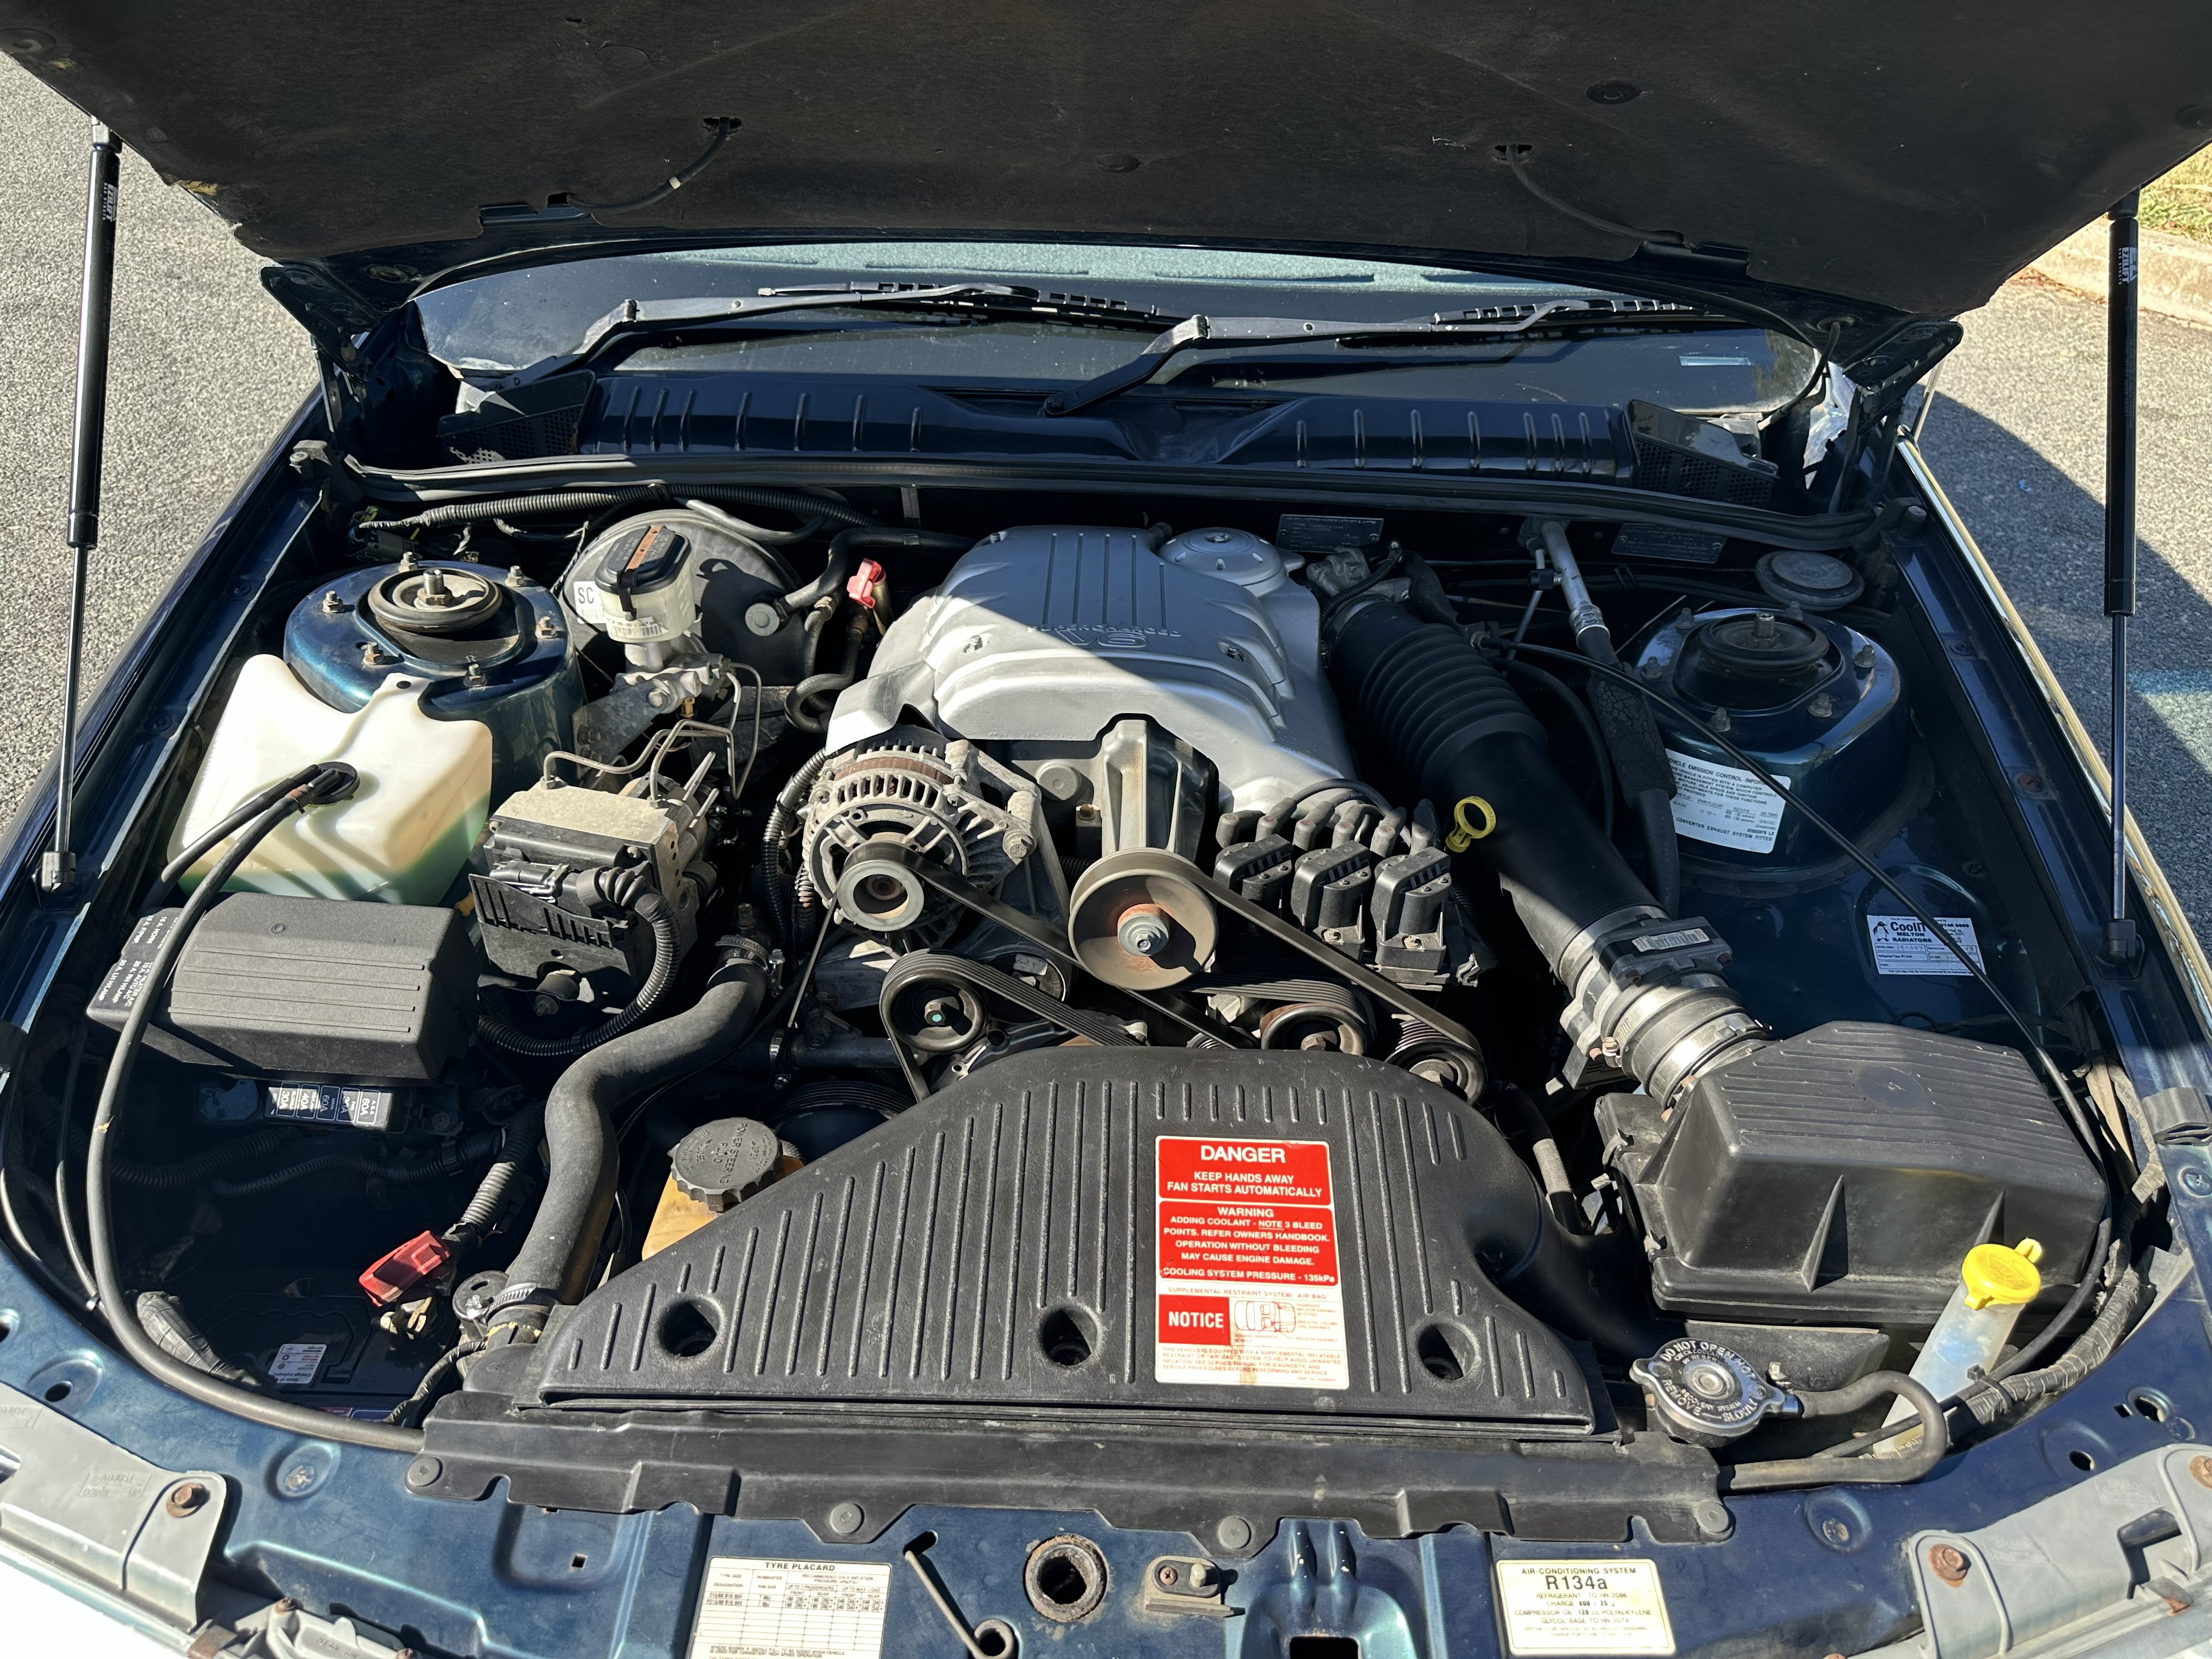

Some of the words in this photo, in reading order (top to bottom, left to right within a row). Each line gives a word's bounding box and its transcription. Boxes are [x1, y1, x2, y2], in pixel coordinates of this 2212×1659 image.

[106, 184, 114, 222] EZILIFT
[578, 587, 594, 603] SC
[1028, 624, 1181, 637] SUPERCHARGED
[1056, 630, 1147, 648] V6
[1668, 758, 1686, 768] EHICLE
[1688, 765, 1713, 775] EMISSION
[1716, 772, 1742, 781] CONTROL
[1682, 783, 1713, 794] ADJUSTMENTS
[1684, 775, 1714, 785] MANAGEMENT
[1676, 817, 1705, 828] CONVERTER
[1707, 826, 1730, 834] EXHAUST
[146, 928, 160, 944] HORN
[124, 974, 133, 983] RH
[129, 974, 140, 990] AUTO
[99, 980, 114, 1001] H/LAMP
[112, 983, 128, 1003] H/LAMP
[279, 1091, 290, 1109] 30A
[300, 1093, 309, 1110] 40A
[320, 1094, 329, 1112] 60A
[341, 1096, 350, 1113] 30A
[360, 1098, 370, 1115] 60A
[732, 1123, 747, 1148] POWER
[713, 1142, 728, 1164] FLUID
[1200, 1145, 1286, 1164] DANGER
[719, 1149, 739, 1184] STEERING
[1194, 1171, 1222, 1181] KEEP
[1224, 1173, 1262, 1183] HANDS
[1265, 1175, 1294, 1184] AWAY
[1167, 1182, 1188, 1192] FAN
[1190, 1183, 1232, 1194] STARTS
[1234, 1186, 1322, 1198] AUTOMATICALLY
[1217, 1207, 1274, 1218] WARNING
[1170, 1216, 1205, 1224] ADDING
[1207, 1217, 1251, 1226] COOLANT
[1259, 1220, 1283, 1228] NOTE
[1164, 1228, 1199, 1236] POINTS.
[1233, 1231, 1273, 1239] OWNERS
[1275, 1233, 1330, 1242] HANDBOOK.
[1175, 1240, 1228, 1249] OPERATION
[1229, 1243, 1270, 1251] WITHOUT
[1273, 1244, 1319, 1253] BLEEDING
[1203, 1254, 1234, 1262] CAUSE
[1273, 1257, 1314, 1266] DAMAGE.
[1163, 1267, 1205, 1277] COOLING
[1207, 1269, 1244, 1278] SYSTEM
[1246, 1271, 1296, 1280] PRESSURE
[1304, 1274, 1335, 1282] 135kPa
[1168, 1311, 1224, 1328] NOTICE
[1661, 1348, 1676, 1362] DO
[1677, 1340, 1696, 1352] NOT
[1699, 1341, 1734, 1359] OPEN
[1735, 1358, 1755, 1378] HOT
[1674, 1349, 1692, 1362] CHECK
[1692, 1348, 1724, 1359] COOLANT
[1662, 1379, 1702, 1417] REMOVE
[1722, 1398, 1758, 1422] SLOWLY
[1680, 1389, 1714, 1411] RECOVERY
[1545, 1575, 1607, 1590] R134a
